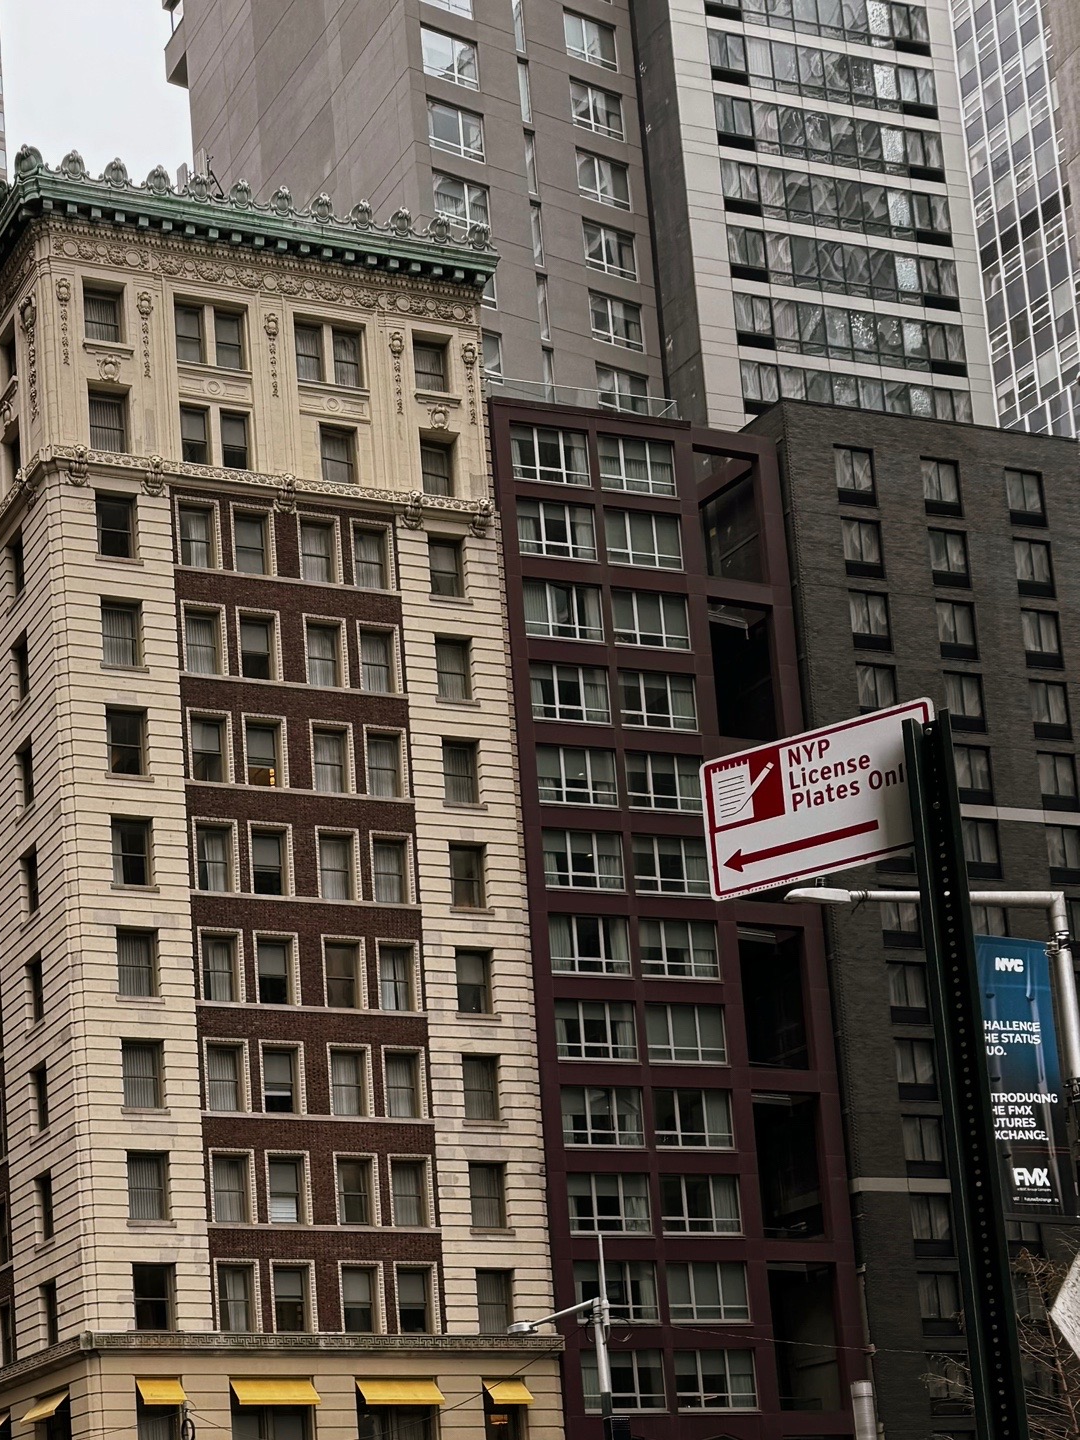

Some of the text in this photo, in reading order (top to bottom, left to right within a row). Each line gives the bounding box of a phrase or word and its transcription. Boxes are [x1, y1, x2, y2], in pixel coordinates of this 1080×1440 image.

[788, 738, 830, 767] NYP
[788, 754, 870, 790] License
[791, 763, 906, 812] Plates Onl
[995, 957, 1024, 973] NYC
[983, 1020, 1041, 1032] HALLENGE
[984, 1033, 1042, 1045] HE STATUS
[986, 1046, 1007, 1056] UO.
[990, 1093, 1058, 1104] TRODUCING
[992, 1105, 1033, 1116] HE FMX
[993, 1117, 1037, 1128] UTURES
[994, 1130, 1049, 1141] XCHANGE.
[1013, 1167, 1051, 1187] FMX
